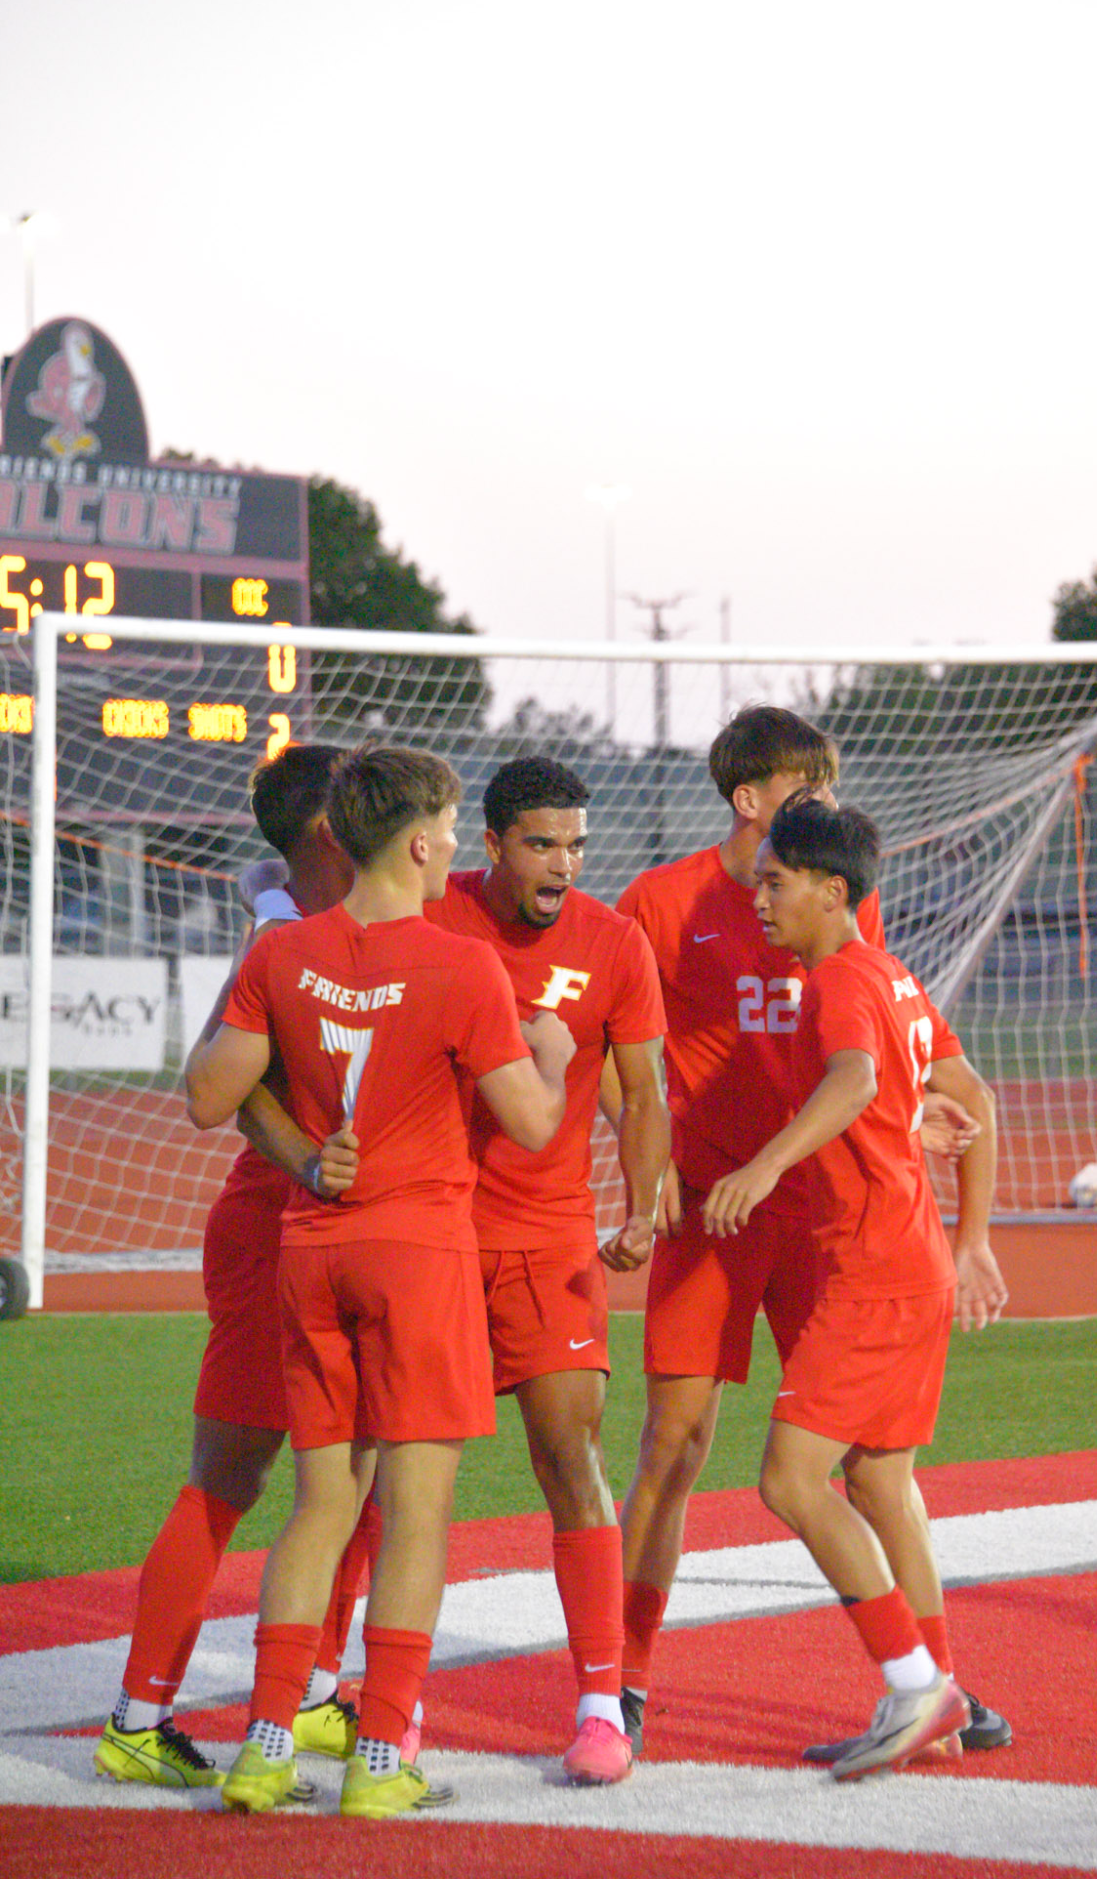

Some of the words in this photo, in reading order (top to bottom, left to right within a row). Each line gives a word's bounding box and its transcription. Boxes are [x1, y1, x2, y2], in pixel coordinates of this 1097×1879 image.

[99, 463, 243, 500] UNIVERSITY
[298, 968, 406, 1012] FRIENDS
[531, 965, 591, 1009] F
[736, 975, 803, 1033] 22
[320, 1016, 374, 1124] 7
